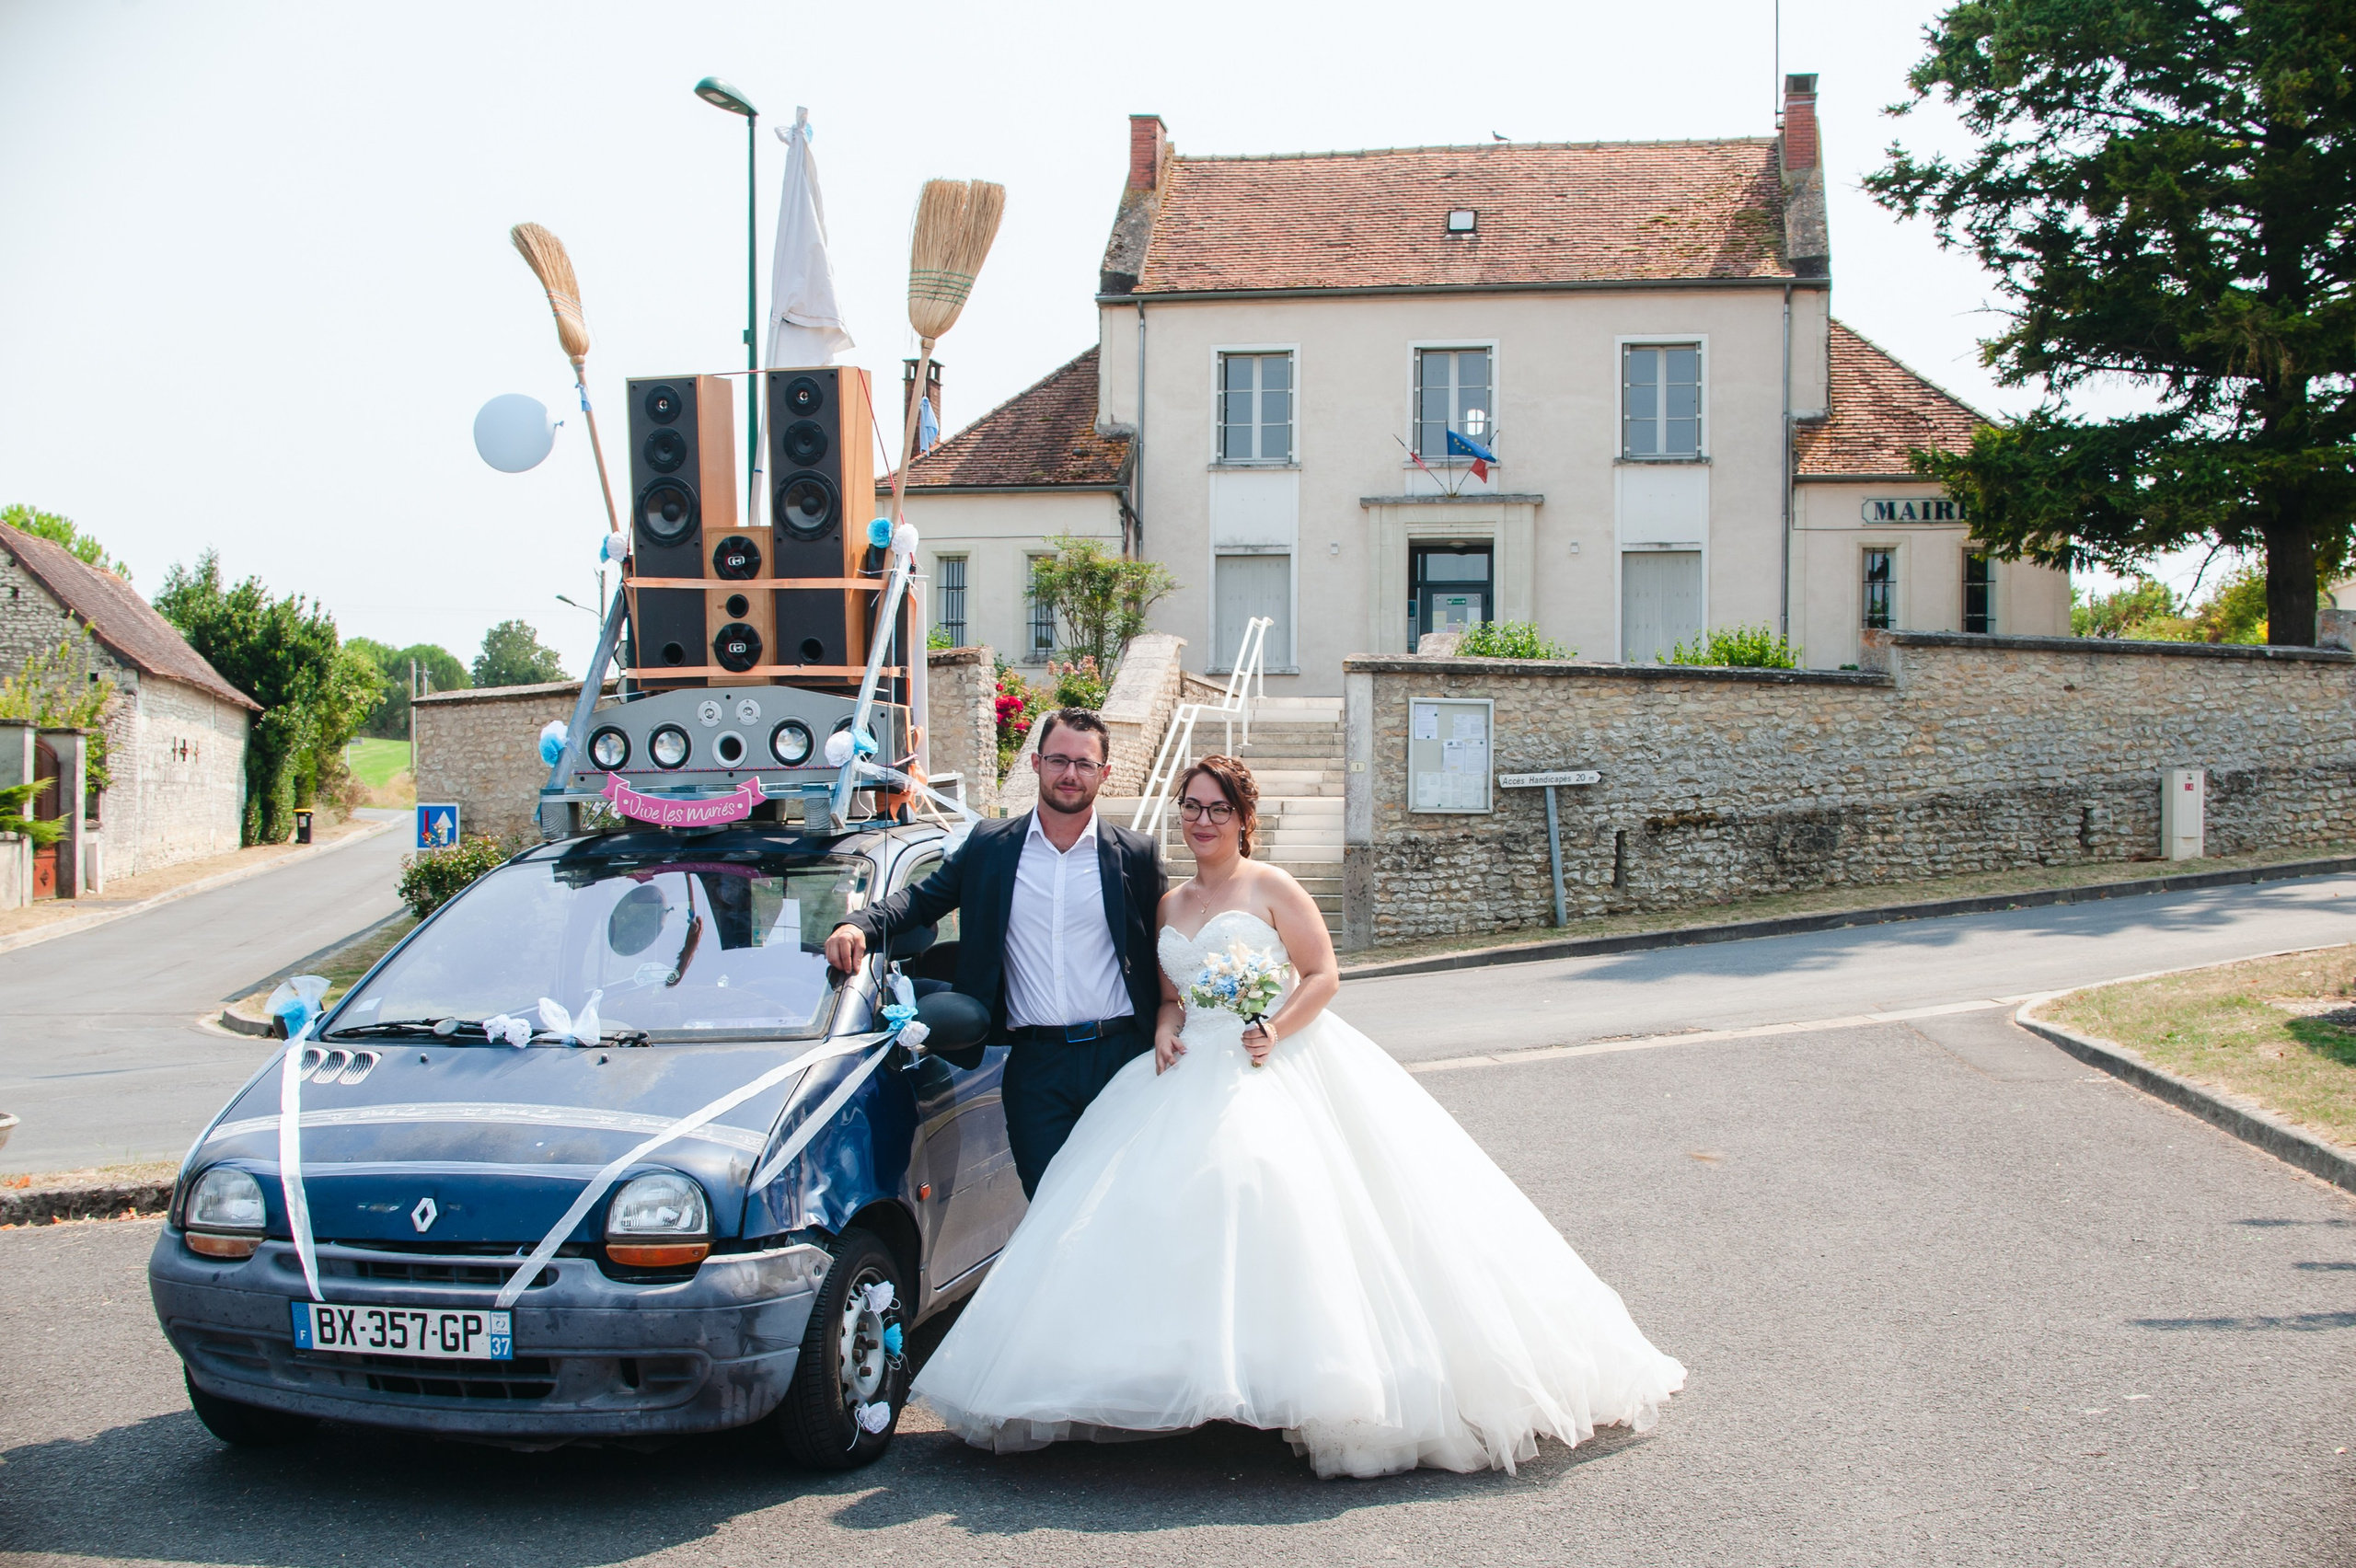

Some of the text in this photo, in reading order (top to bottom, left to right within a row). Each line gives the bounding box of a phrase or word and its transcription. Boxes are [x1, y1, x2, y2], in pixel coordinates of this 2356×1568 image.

[1874, 502, 1967, 520] MAIRI
[1502, 777, 1525, 785] Accès
[1576, 773, 1586, 781] 20
[629, 796, 660, 820] Vive
[663, 804, 683, 823] les
[299, 1308, 511, 1355] F BX-357-GP 37
